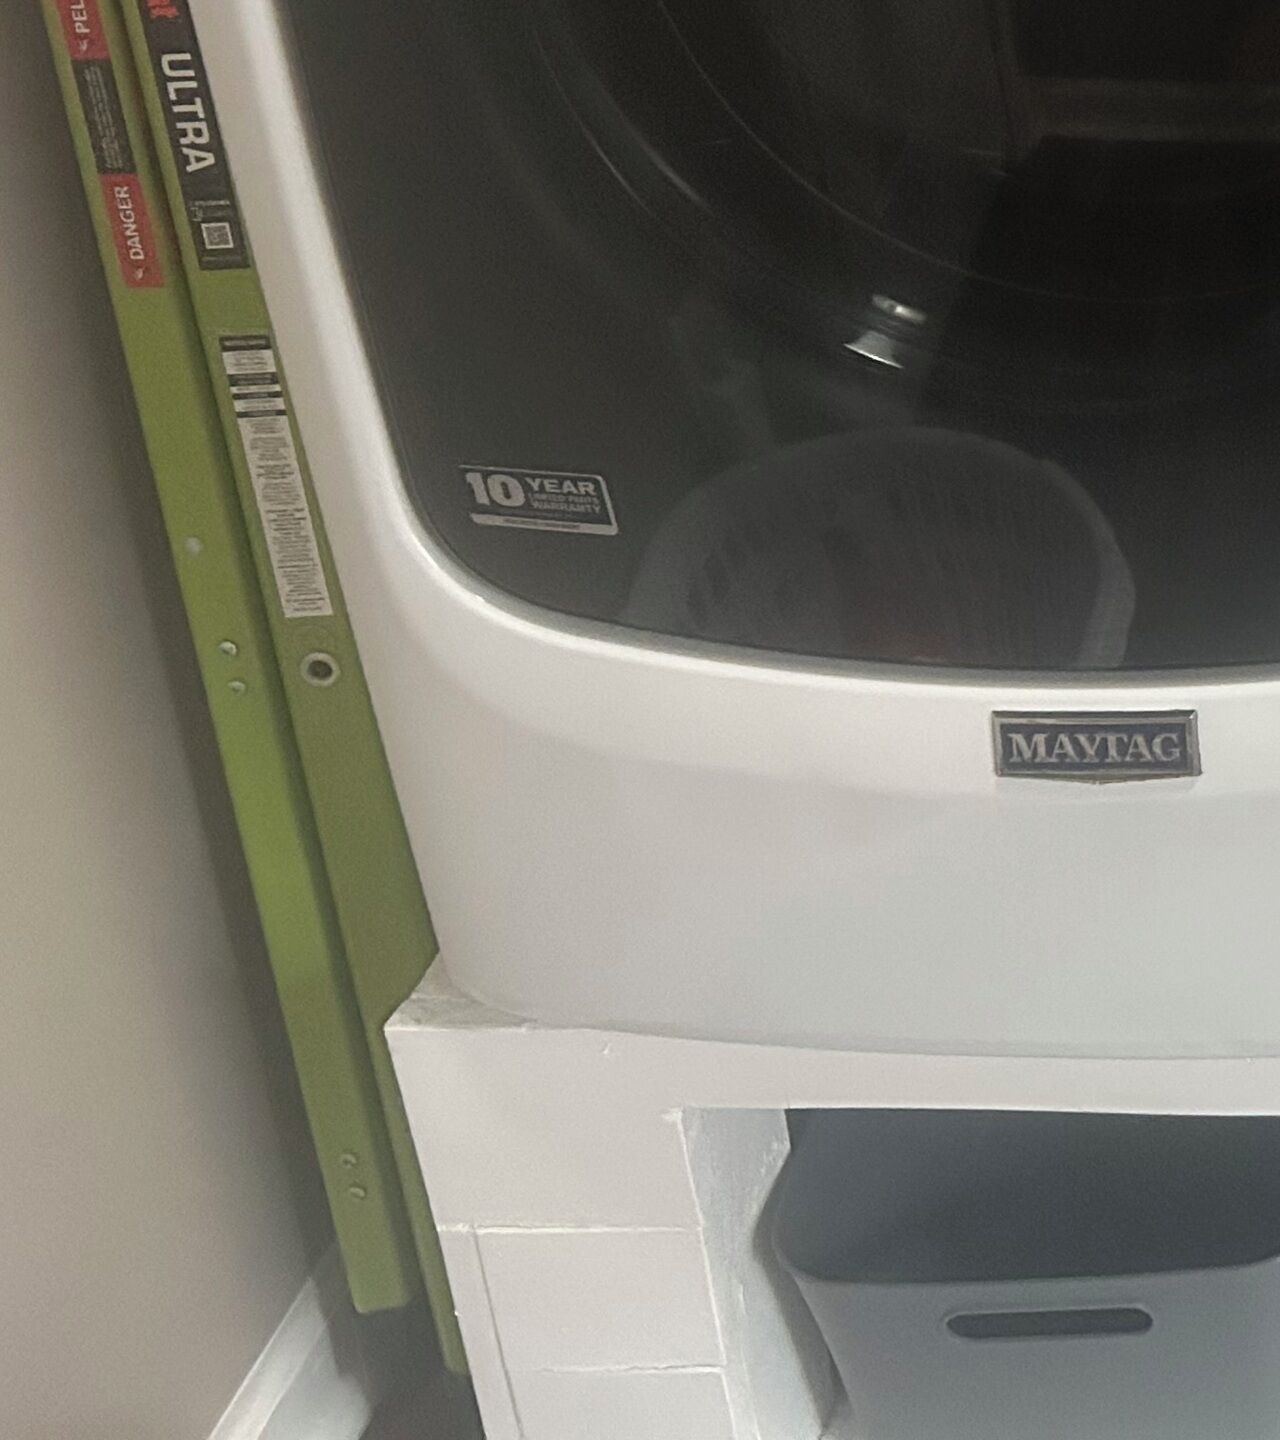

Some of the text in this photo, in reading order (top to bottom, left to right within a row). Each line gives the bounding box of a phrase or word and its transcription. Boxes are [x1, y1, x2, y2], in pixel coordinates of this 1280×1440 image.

[161, 53, 215, 173] ULTRA
[113, 185, 144, 260] DANGER
[466, 472, 596, 506] 10 YEAR
[531, 501, 600, 513] WARRANTY
[1008, 732, 1181, 762] MAYTAG
